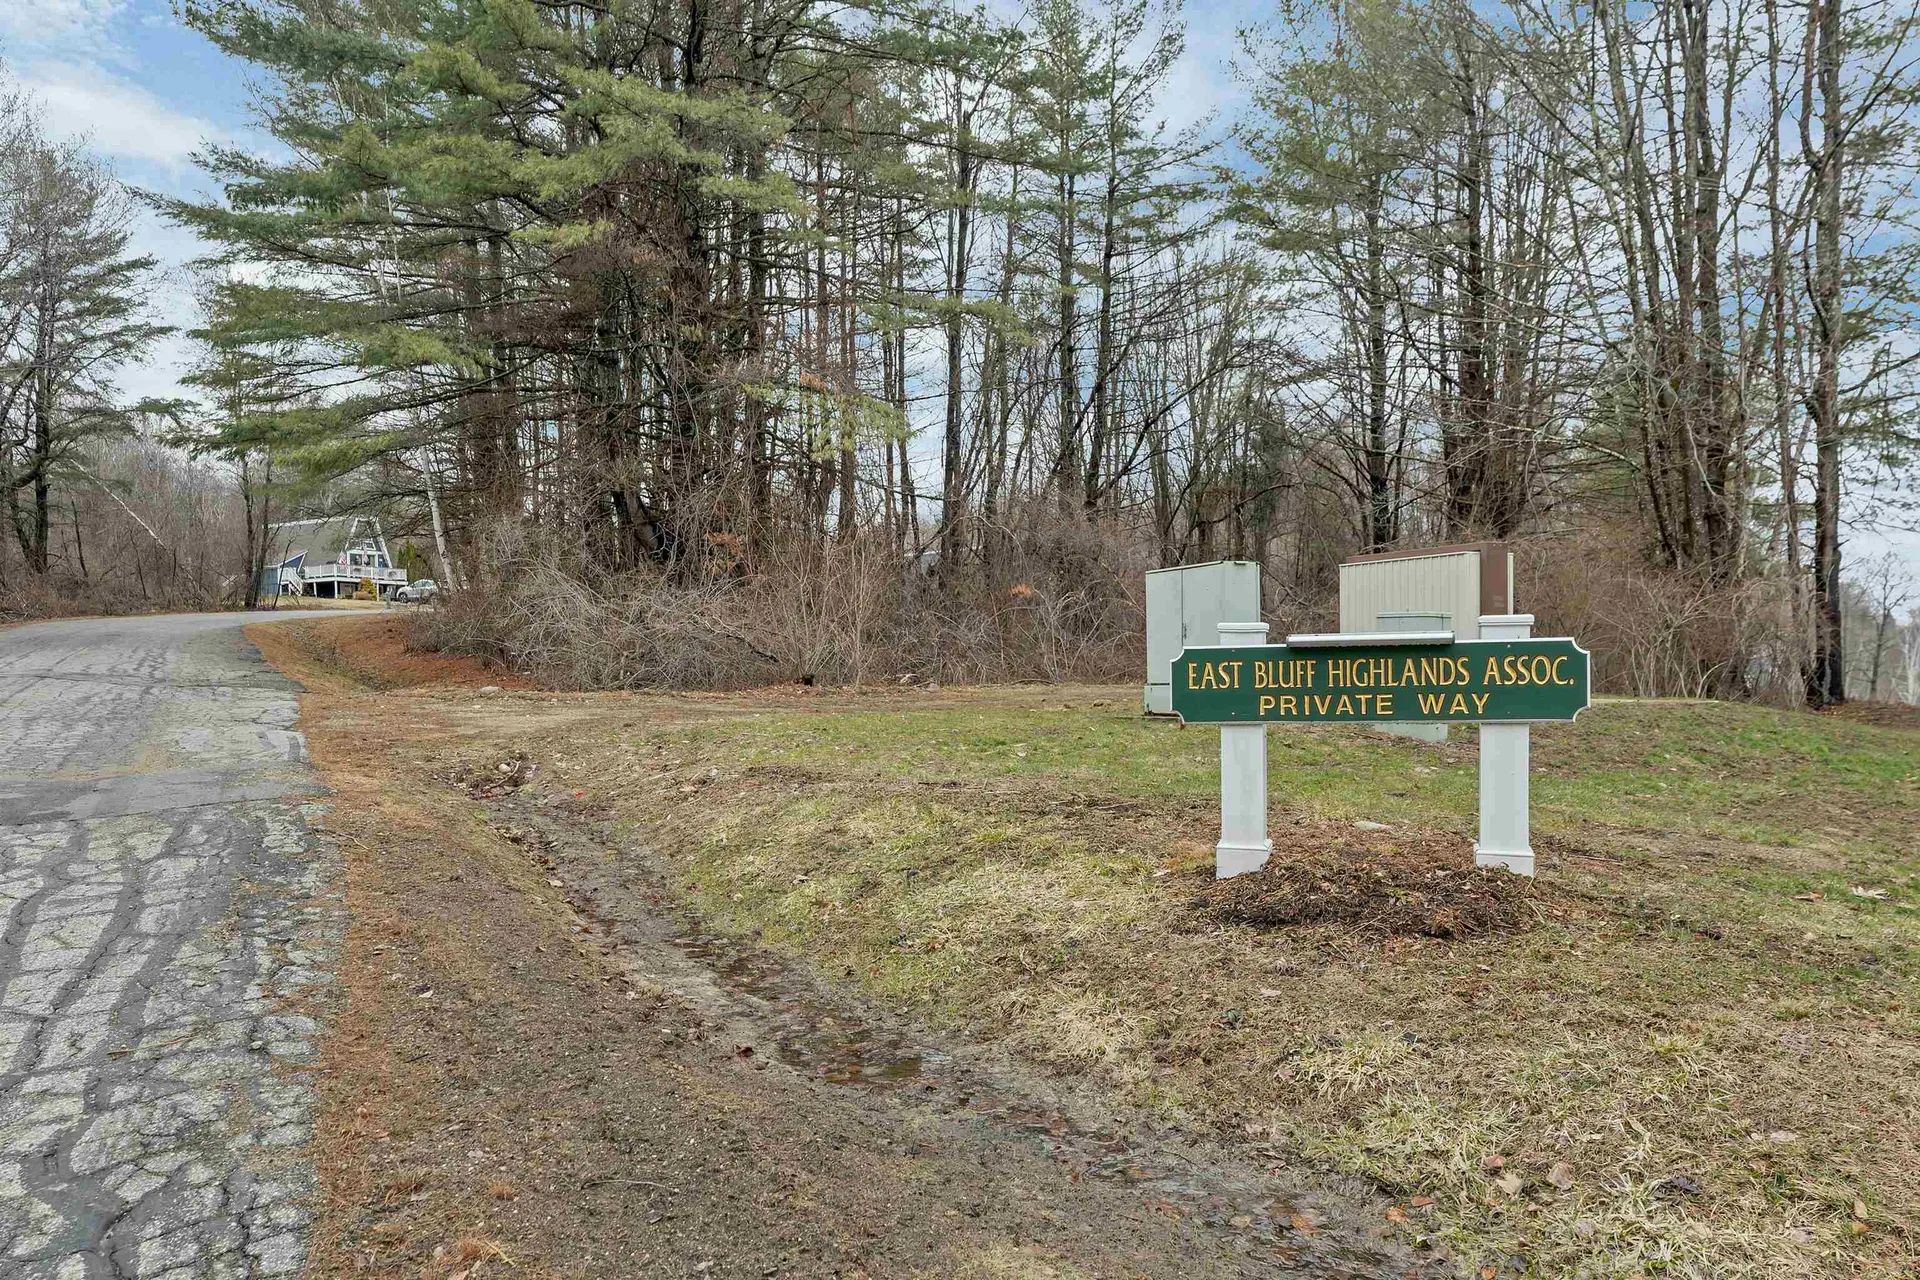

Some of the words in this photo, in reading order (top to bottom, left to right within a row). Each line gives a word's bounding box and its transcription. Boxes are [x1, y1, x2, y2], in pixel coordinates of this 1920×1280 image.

[1188, 660, 1243, 689] EAST
[1254, 660, 1316, 690] BLUFF
[1328, 657, 1470, 689] HIGHLANDS
[1483, 655, 1574, 685] ASSOC.
[1260, 694, 1393, 715] PRIVATE
[1419, 691, 1489, 714] WAY
